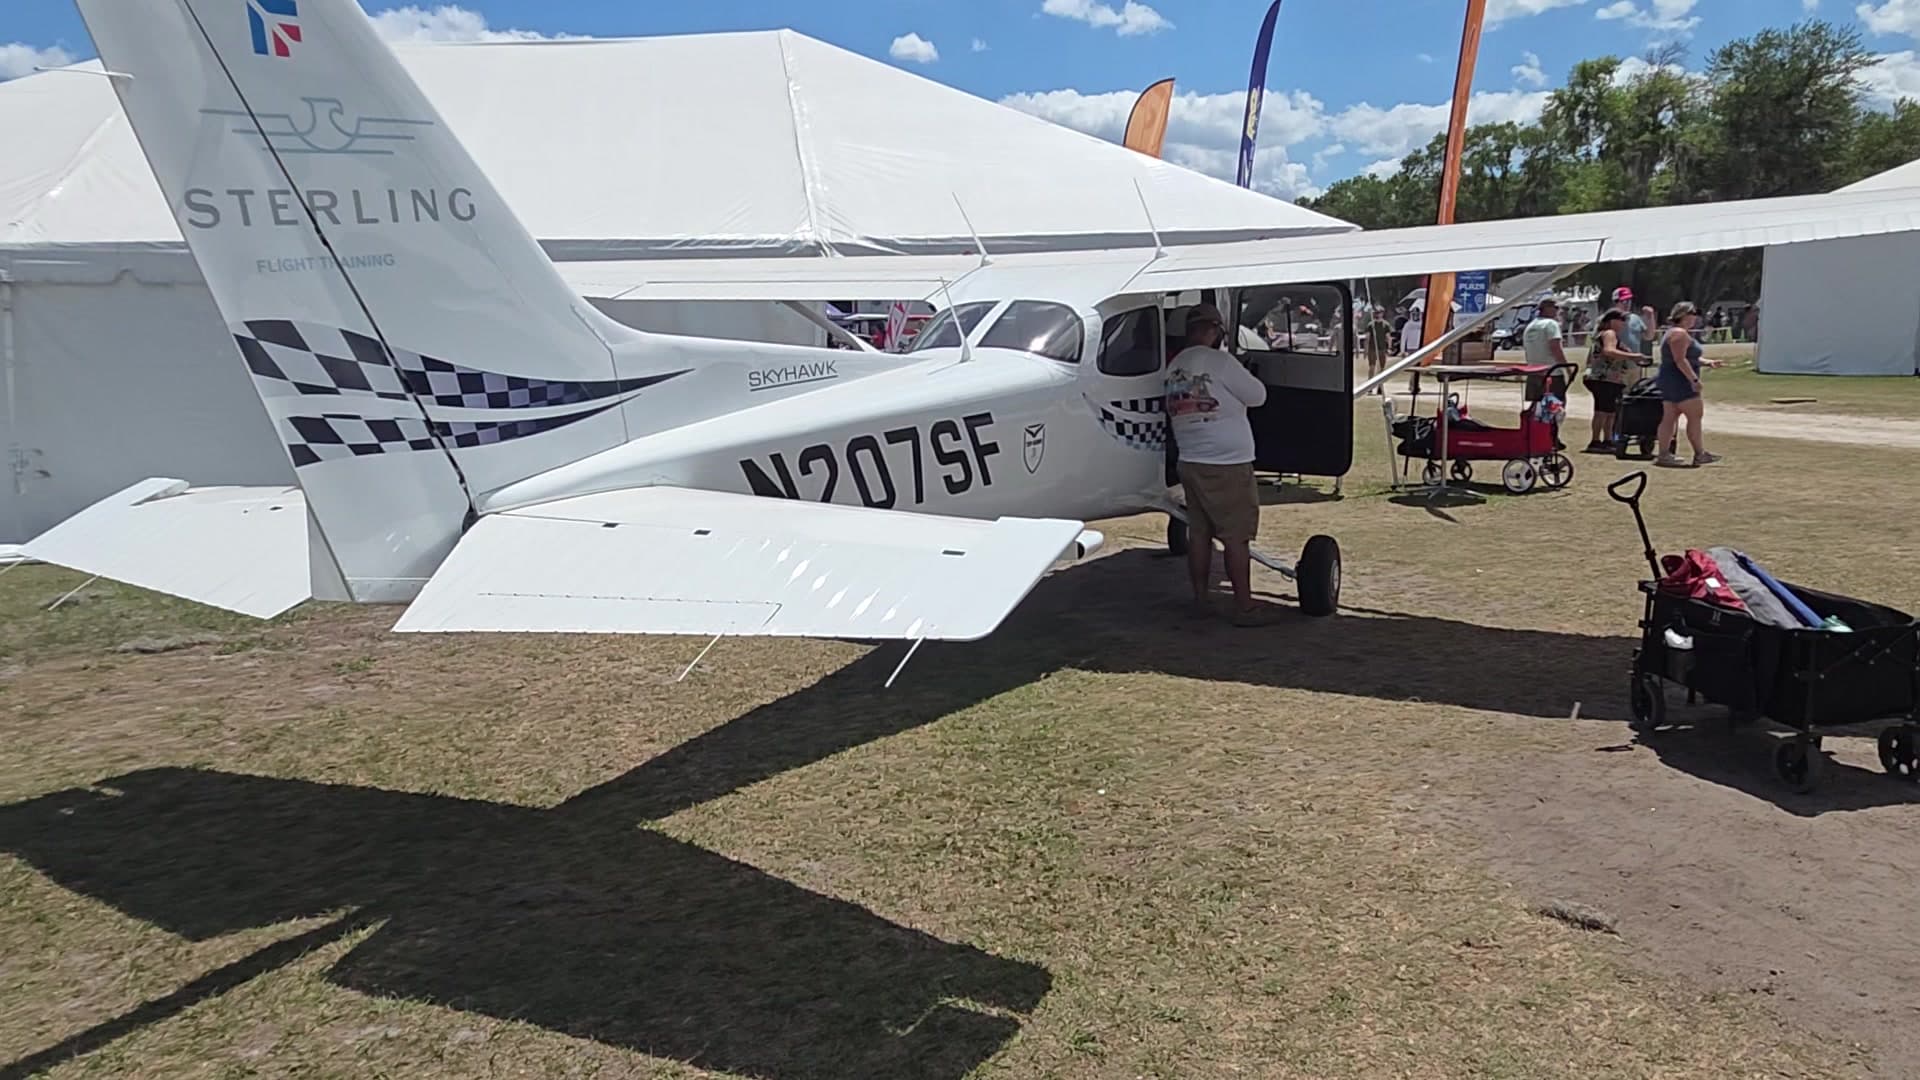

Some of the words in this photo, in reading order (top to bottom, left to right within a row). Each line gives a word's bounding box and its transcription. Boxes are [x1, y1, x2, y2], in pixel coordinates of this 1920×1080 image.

[183, 187, 477, 229] STERLING
[256, 256, 315, 273] FLIGHT
[748, 360, 838, 387] SKYHAWK
[739, 412, 1000, 510] N207SF
